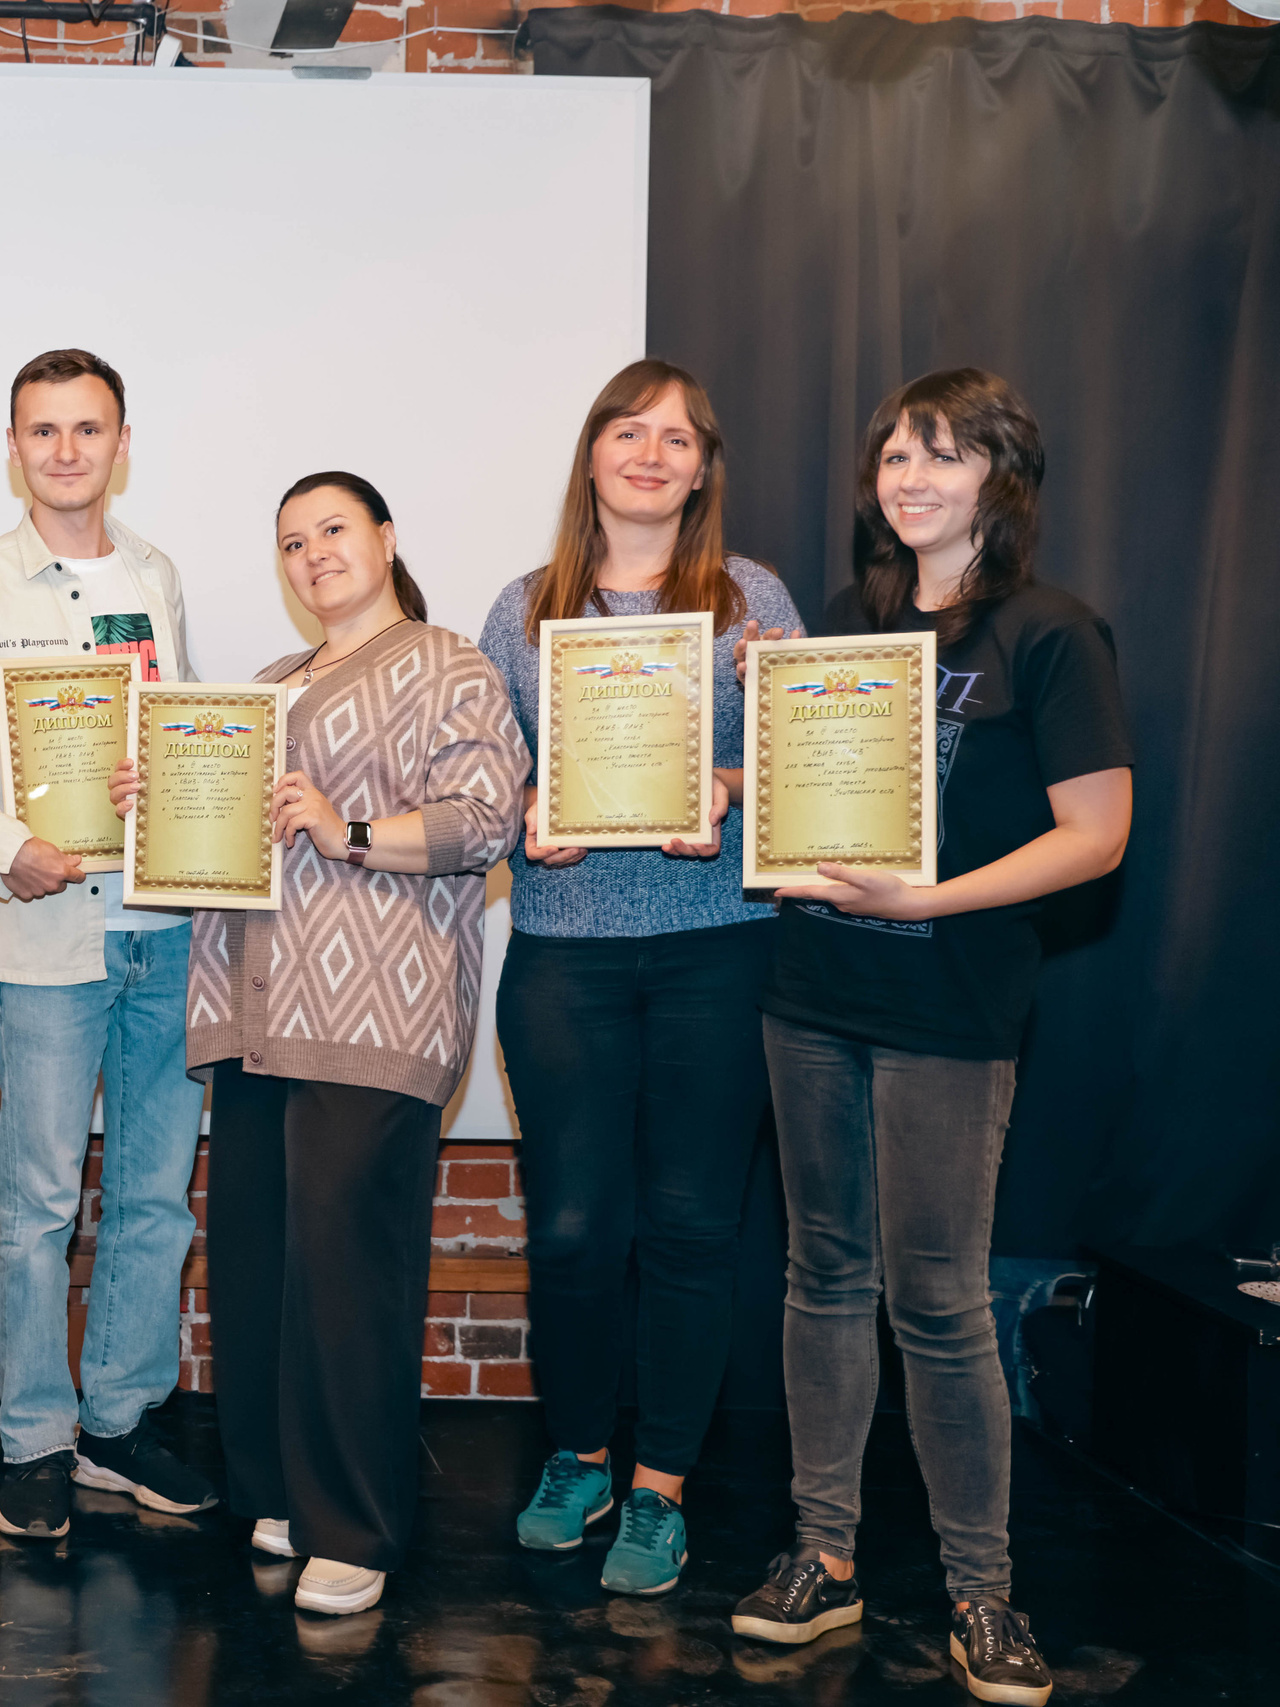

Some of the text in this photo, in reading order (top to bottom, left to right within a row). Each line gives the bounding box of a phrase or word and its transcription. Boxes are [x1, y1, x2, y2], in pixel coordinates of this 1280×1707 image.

[20, 638, 69, 649] Playground
[578, 682, 672, 703] ДИПЛОМ
[789, 701, 892, 723] ДИПЛОМ
[32, 714, 113, 734] ДИПЛОМ
[163, 742, 251, 760] ДИПЛОМ
